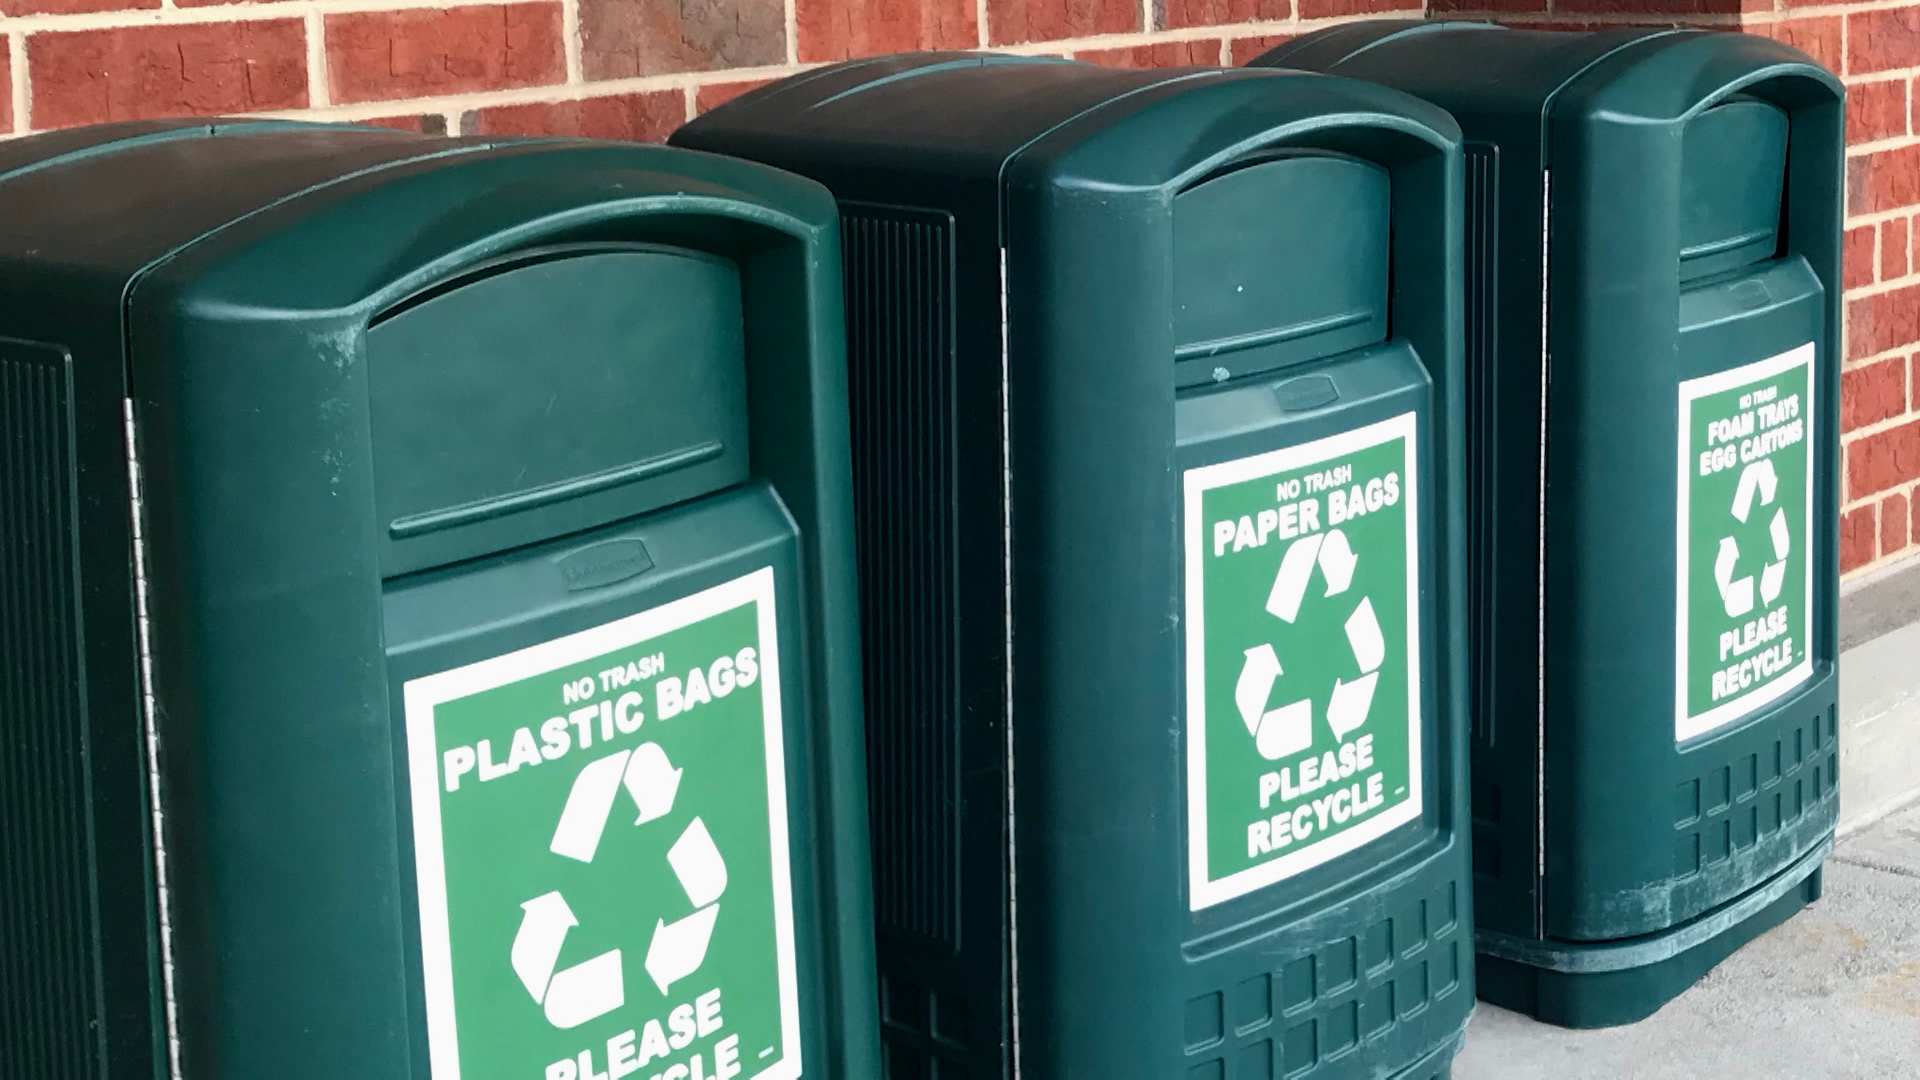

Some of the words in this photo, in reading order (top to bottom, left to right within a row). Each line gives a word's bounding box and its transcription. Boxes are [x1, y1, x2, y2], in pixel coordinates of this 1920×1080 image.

[1699, 443, 1737, 476] EGG
[1740, 417, 1803, 463] CARTONS
[1707, 411, 1755, 446] FOAM
[1757, 393, 1799, 430] TRAYS
[1276, 479, 1301, 502] NO
[1303, 463, 1352, 494] TRASH
[1213, 498, 1321, 557] PAPER
[1328, 471, 1400, 526] BAGS
[1719, 604, 1788, 662] PLEASE
[562, 676, 596, 705] NO
[597, 651, 665, 692] TRASH
[1711, 637, 1793, 702] RECYCLE
[443, 691, 645, 792] PLASTIC
[656, 646, 759, 721] BAGS
[1259, 733, 1374, 809] PLEASE
[1247, 771, 1384, 858] RECYCLE
